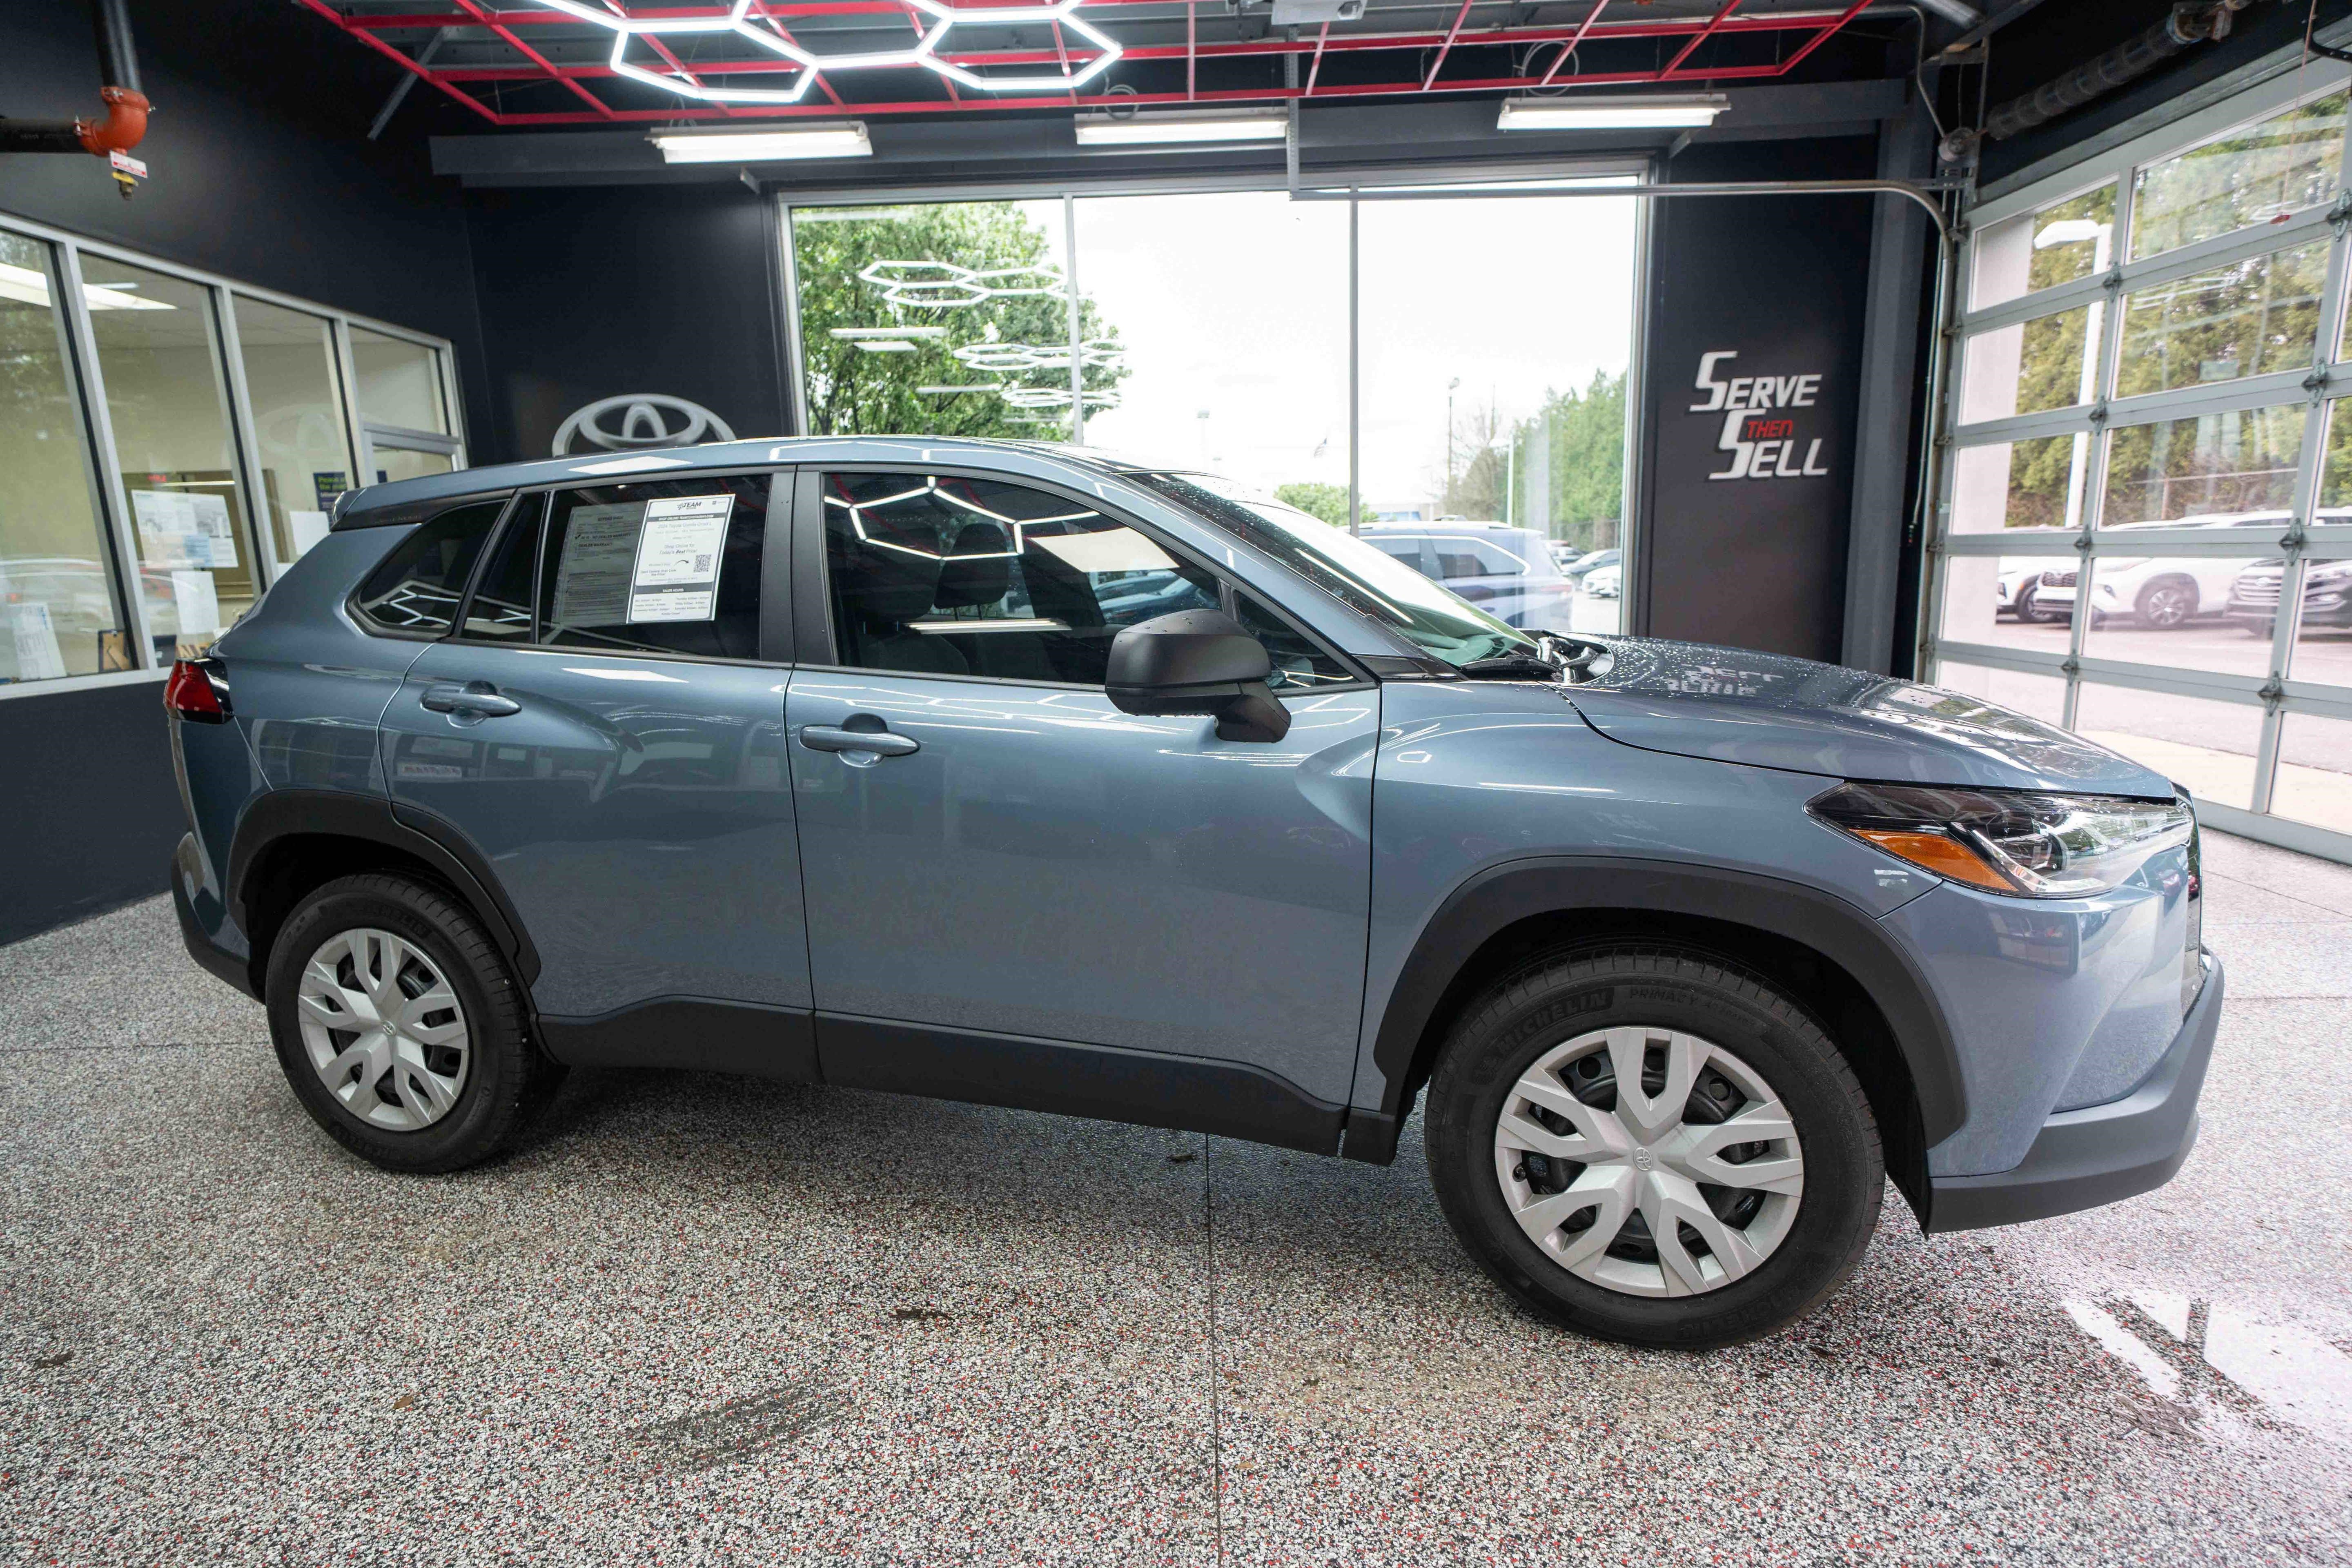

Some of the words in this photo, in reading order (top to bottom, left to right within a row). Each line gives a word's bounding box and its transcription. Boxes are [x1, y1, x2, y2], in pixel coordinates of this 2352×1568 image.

[1689, 351, 1822, 411] SERVE
[1708, 408, 1828, 480] SELL
[1747, 419, 1794, 439] THEN
[1496, 990, 1608, 1056] MICHELIN
